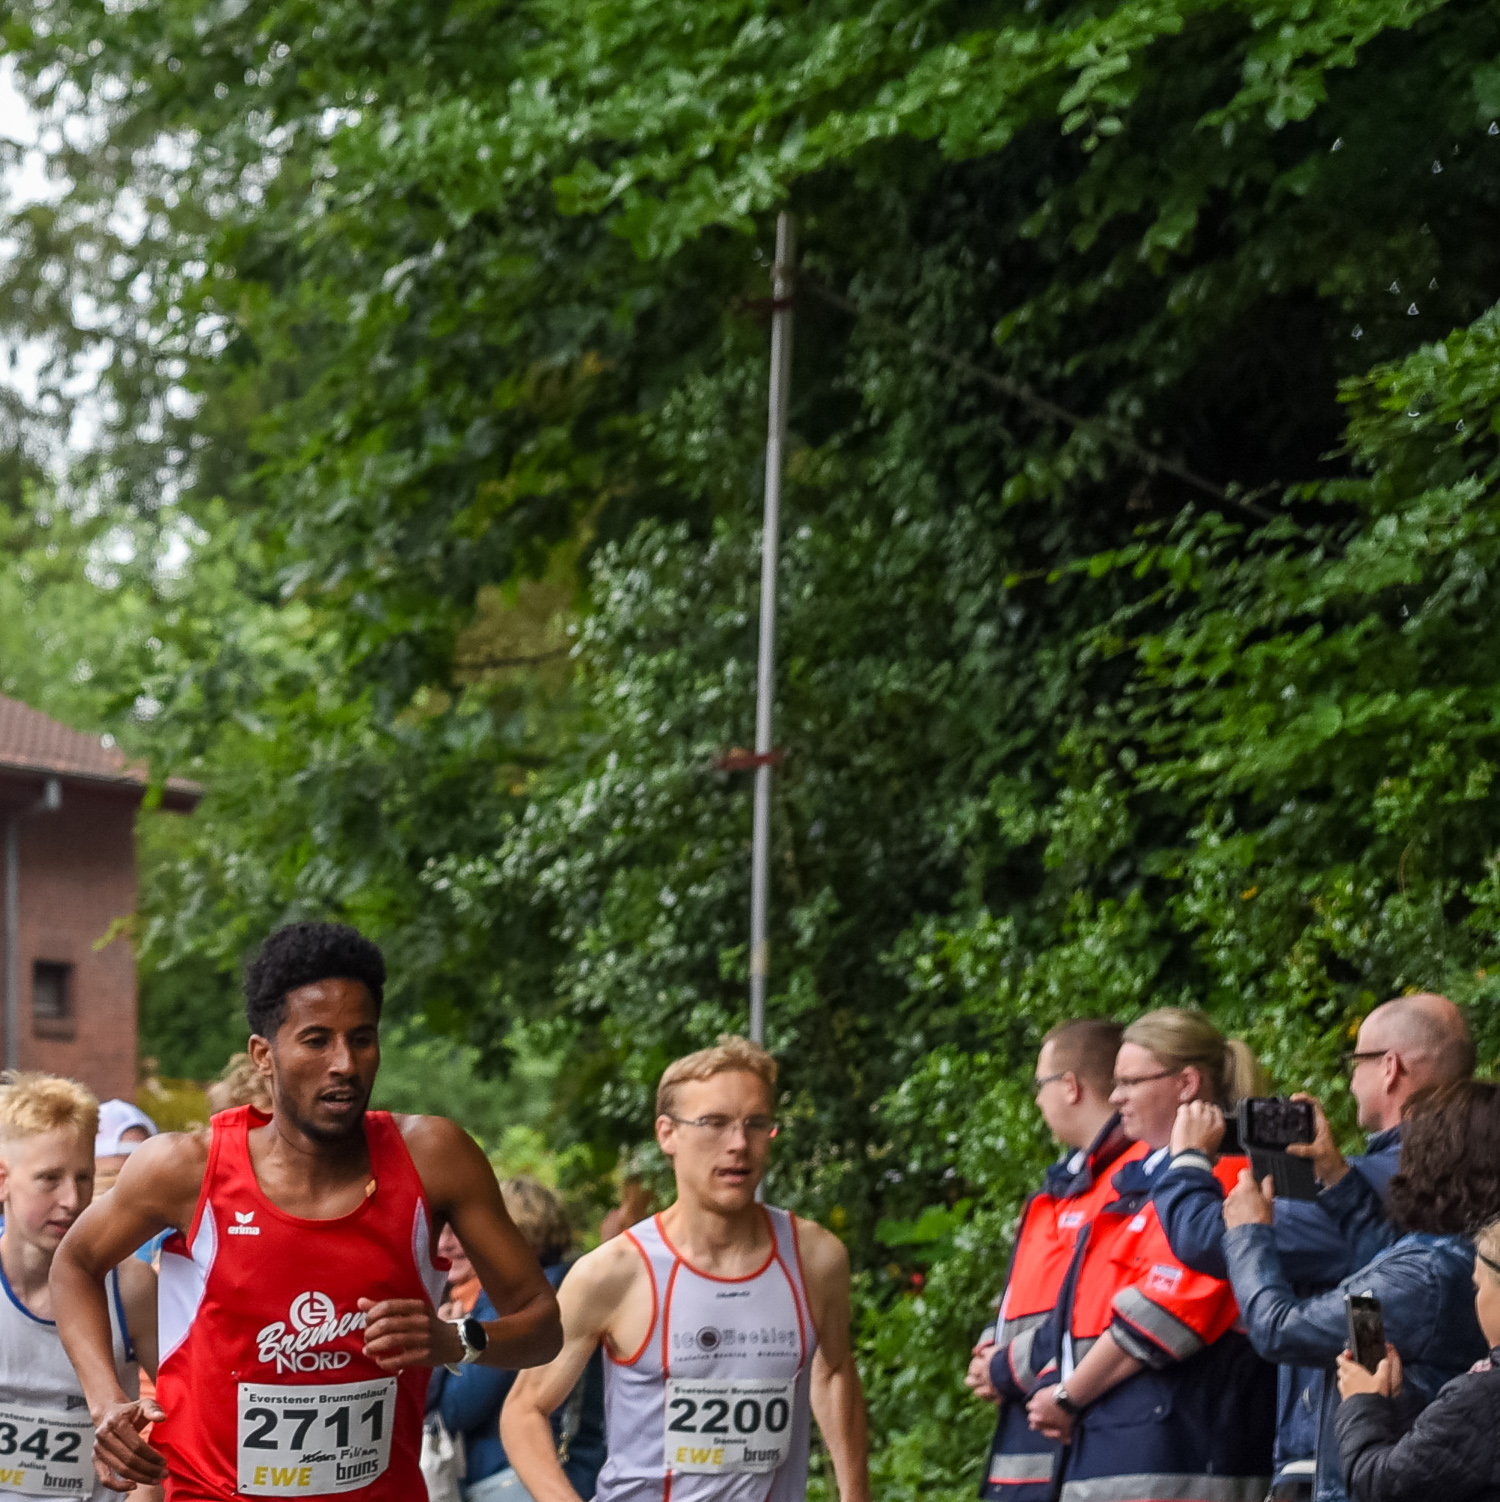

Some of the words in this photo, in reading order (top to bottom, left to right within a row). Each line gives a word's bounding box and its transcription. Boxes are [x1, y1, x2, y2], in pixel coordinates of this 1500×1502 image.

[227, 1224, 260, 1236] erima
[276, 1351, 351, 1374] NORD
[249, 1394, 315, 1404] Everstener
[319, 1386, 388, 1404] Brunnenlauf
[243, 1400, 384, 1451] 2711
[668, 1397, 790, 1434] 2200
[676, 1446, 725, 1465] EWE
[742, 1446, 781, 1463] bruns
[43, 1472, 84, 1489] bruns
[253, 1466, 313, 1487] EWE
[336, 1458, 379, 1481] bruns
